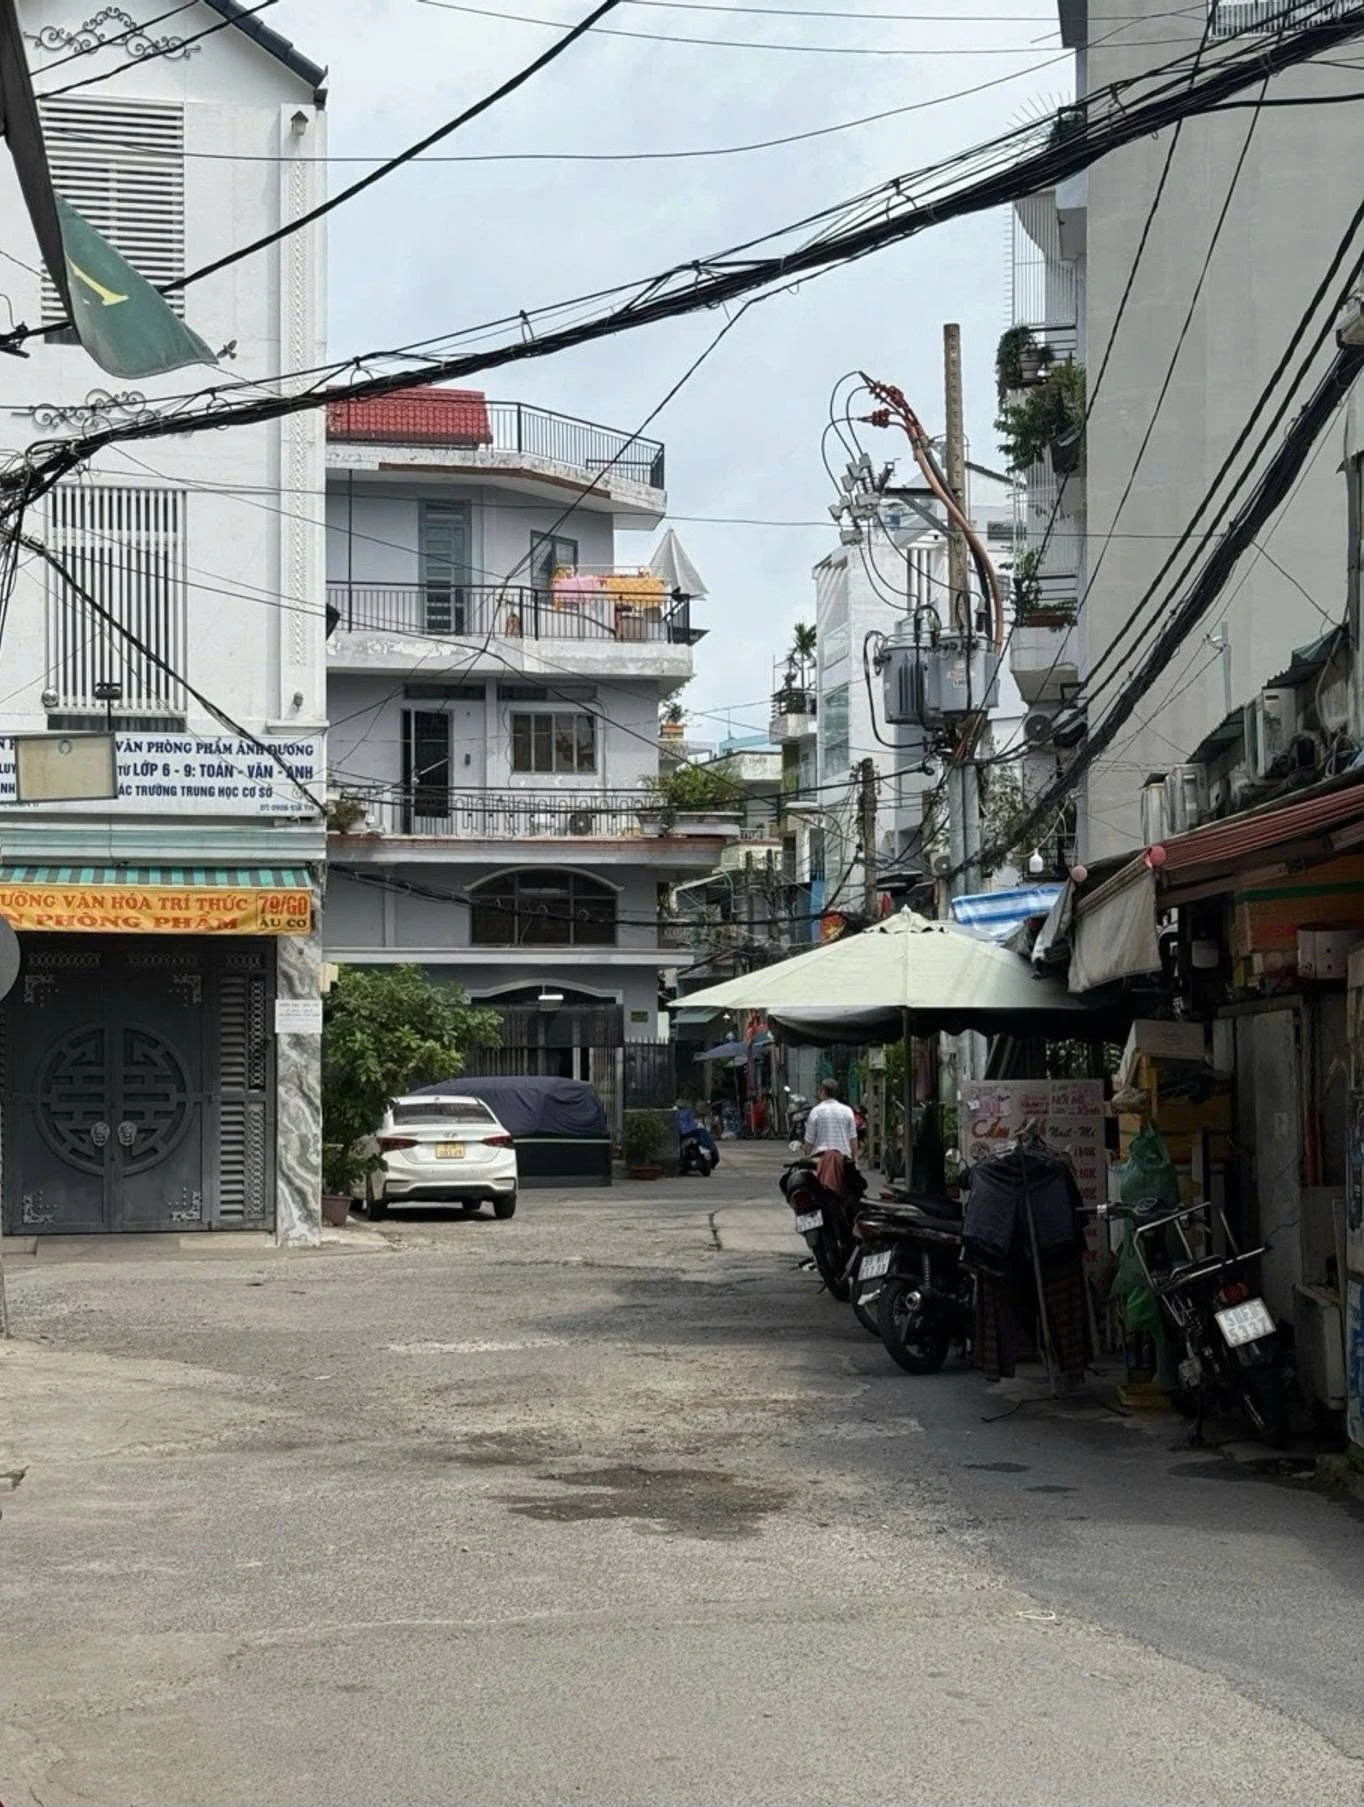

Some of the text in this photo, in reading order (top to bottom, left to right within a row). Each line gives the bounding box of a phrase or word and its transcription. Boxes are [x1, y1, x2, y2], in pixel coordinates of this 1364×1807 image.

[115, 738, 143, 753] VĂN
[146, 739, 192, 754] PHÒNG
[196, 737, 233, 754] PHẨM
[133, 760, 158, 777] LỚP
[162, 762, 170, 777] 6
[200, 762, 234, 778] TOÁN
[248, 762, 273, 778] VĂN
[135, 784, 178, 797] TRƯỜNG
[180, 786, 215, 798] TRUNG
[218, 786, 239, 800] HỌC
[242, 786, 256, 798] CƠ
[258, 784, 273, 798] SỞ
[62, 891, 105, 909] VĂN
[111, 892, 152, 910] HÓA
[158, 894, 190, 911] TRÍ
[196, 894, 248, 912] THỨC
[34, 912, 141, 928] PHÒNG
[152, 911, 240, 930] PHẨM
